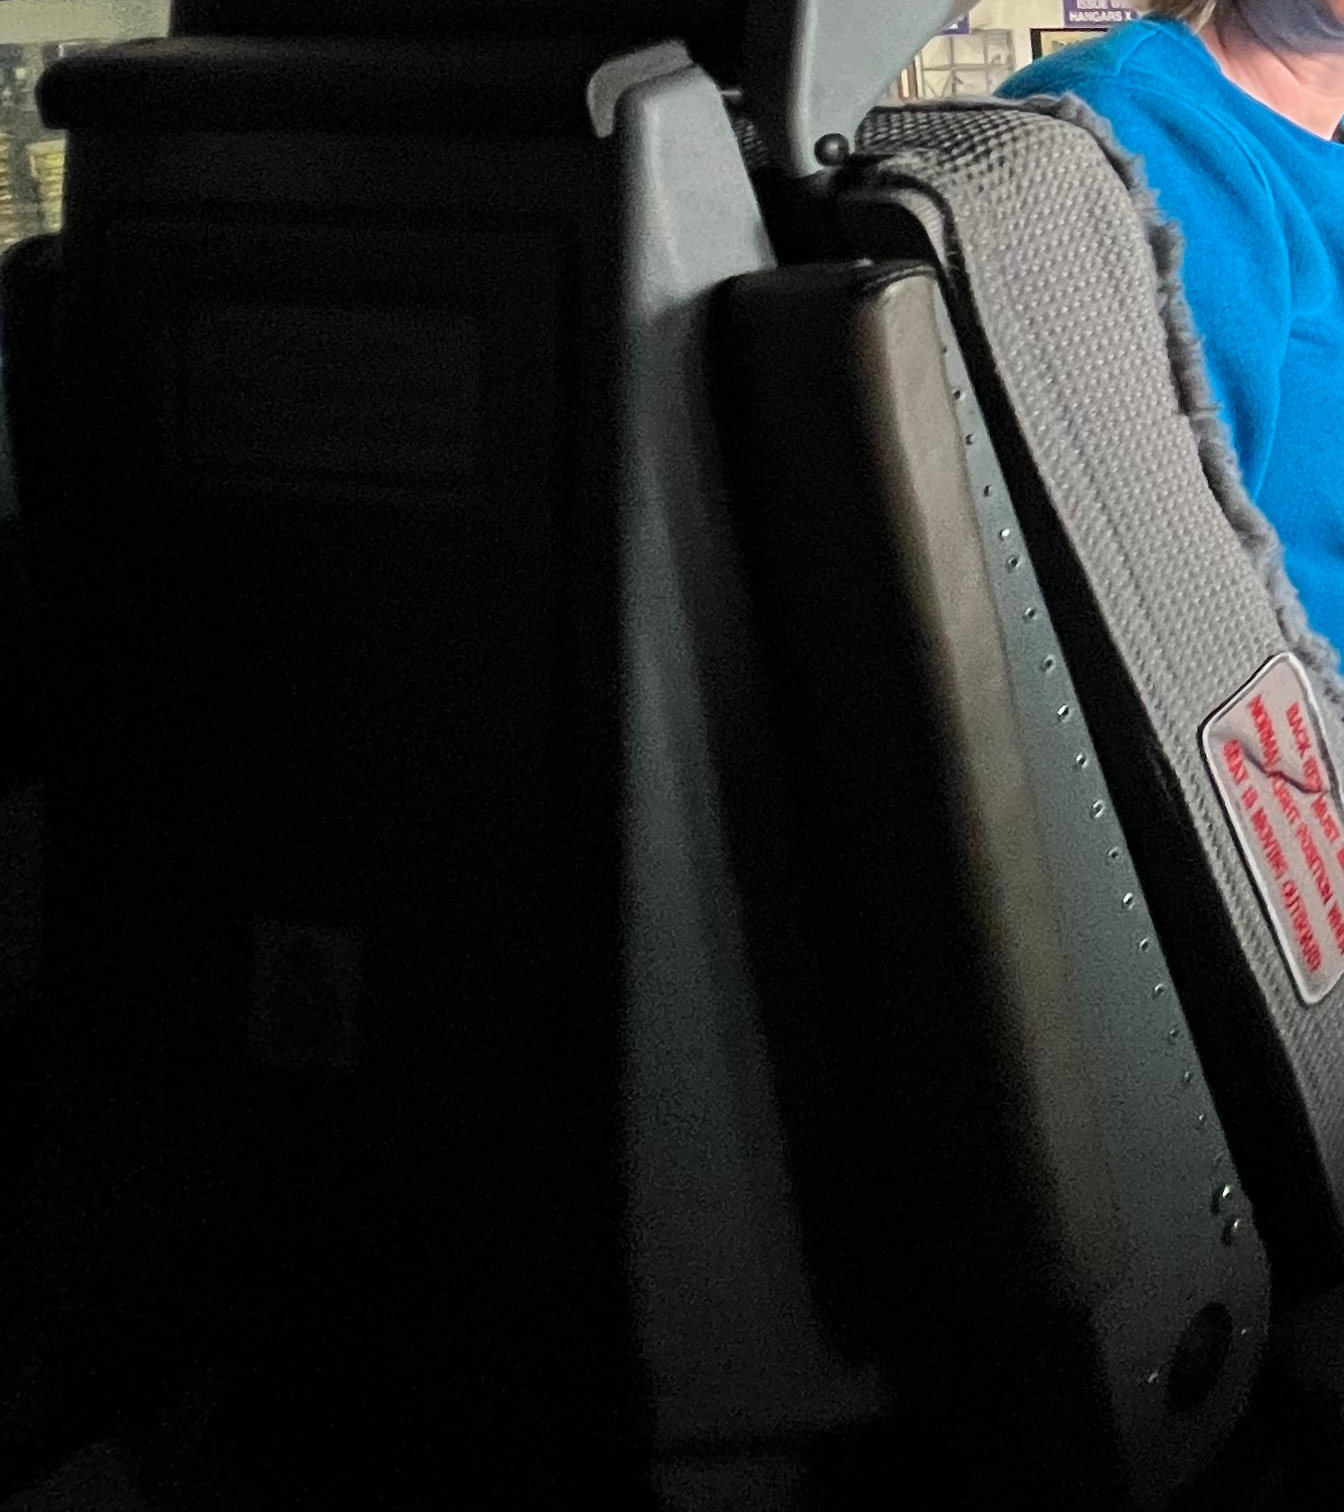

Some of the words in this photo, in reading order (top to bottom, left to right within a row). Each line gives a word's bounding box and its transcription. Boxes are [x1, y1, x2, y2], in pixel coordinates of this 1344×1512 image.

[1068, 10, 1123, 23] HANGARS
[1285, 701, 1311, 758] BACK
[1311, 793, 1341, 843] MUST
[1296, 821, 1334, 905] POSITION
